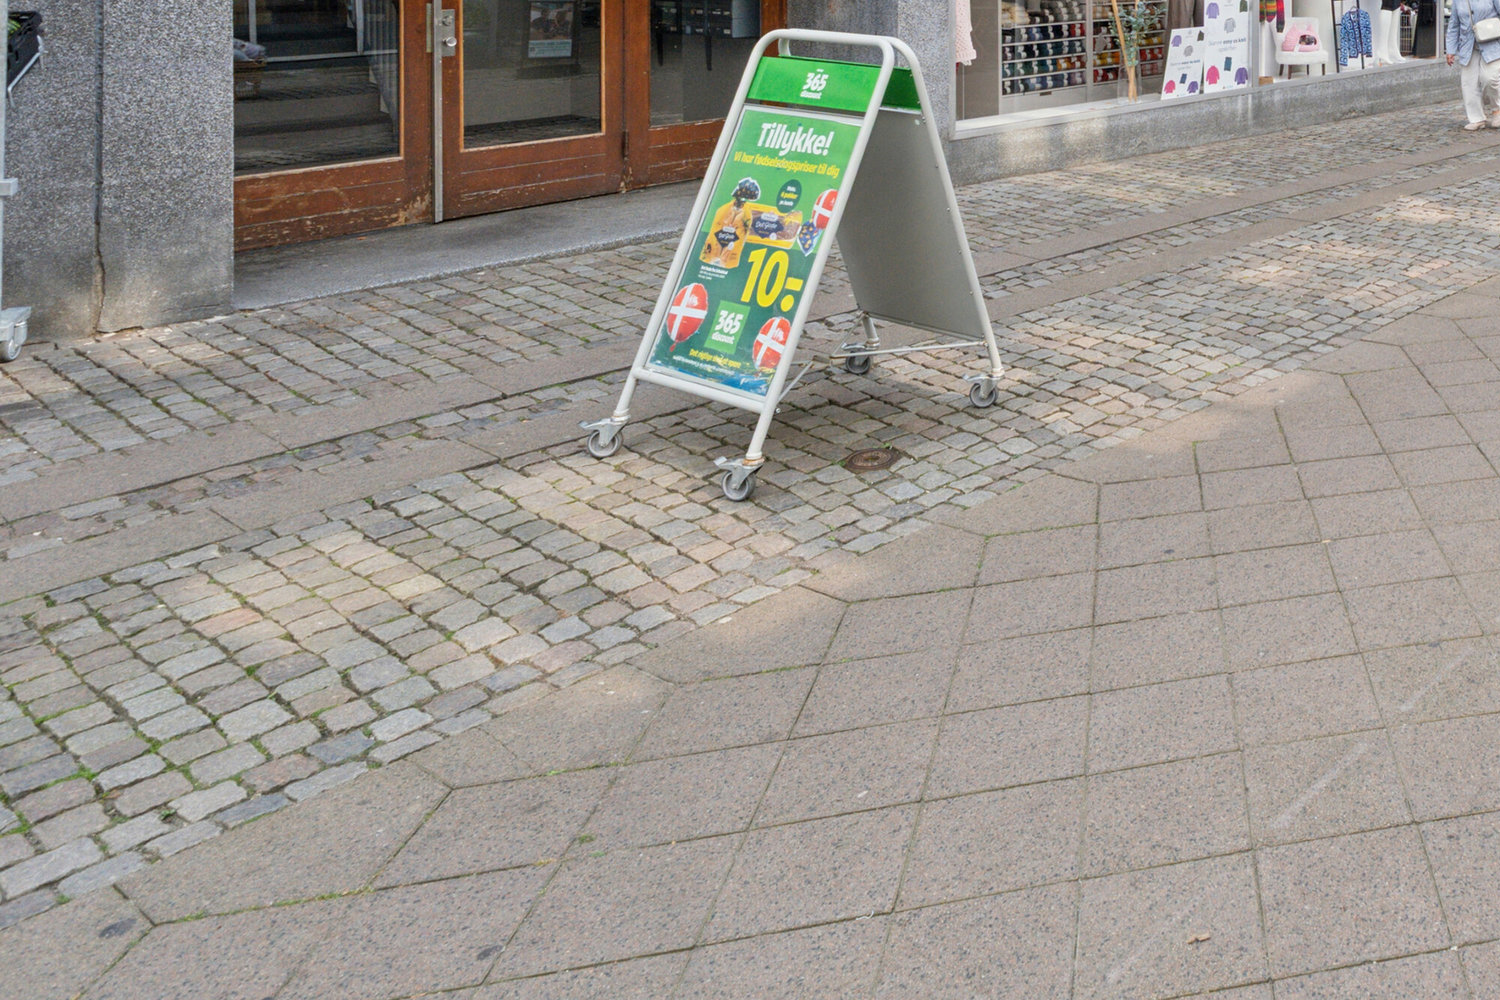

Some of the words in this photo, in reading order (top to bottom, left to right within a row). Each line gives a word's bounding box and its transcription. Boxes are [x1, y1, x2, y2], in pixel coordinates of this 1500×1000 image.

[802, 72, 829, 92] 365
[757, 122, 835, 156] Tillykke!
[733, 151, 741, 161] Vi
[741, 153, 754, 164] har
[817, 163, 828, 175] til
[827, 164, 840, 179] dig
[714, 309, 744, 335] 365
